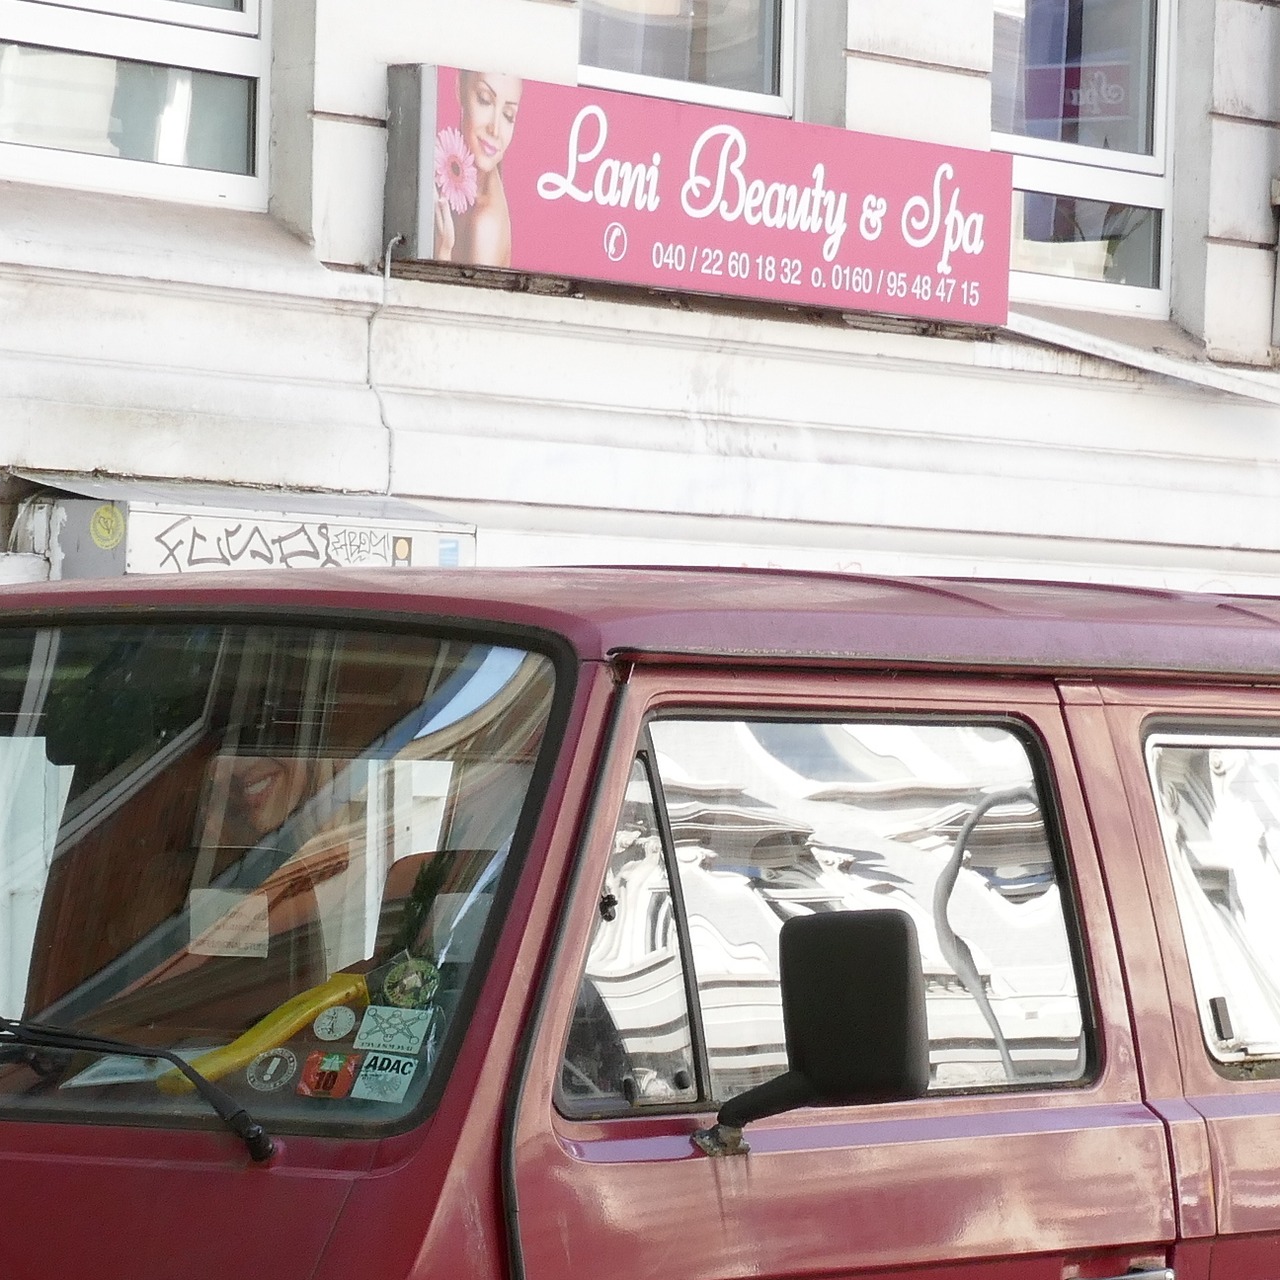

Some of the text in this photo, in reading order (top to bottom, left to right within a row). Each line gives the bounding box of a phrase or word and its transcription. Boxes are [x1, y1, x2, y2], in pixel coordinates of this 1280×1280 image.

[536, 104, 986, 275] Lani Beauty & Spa
[651, 240, 686, 272] 040
[701, 247, 723, 276] 22
[726, 251, 750, 280] 60
[756, 255, 777, 283] 18
[780, 257, 802, 286] 32
[811, 266, 827, 289] o.
[831, 263, 874, 295] 0160
[886, 269, 908, 298] 95
[911, 273, 932, 301] 48
[935, 276, 956, 304] 47
[960, 279, 981, 307] 15
[364, 1055, 413, 1075] ADAC
